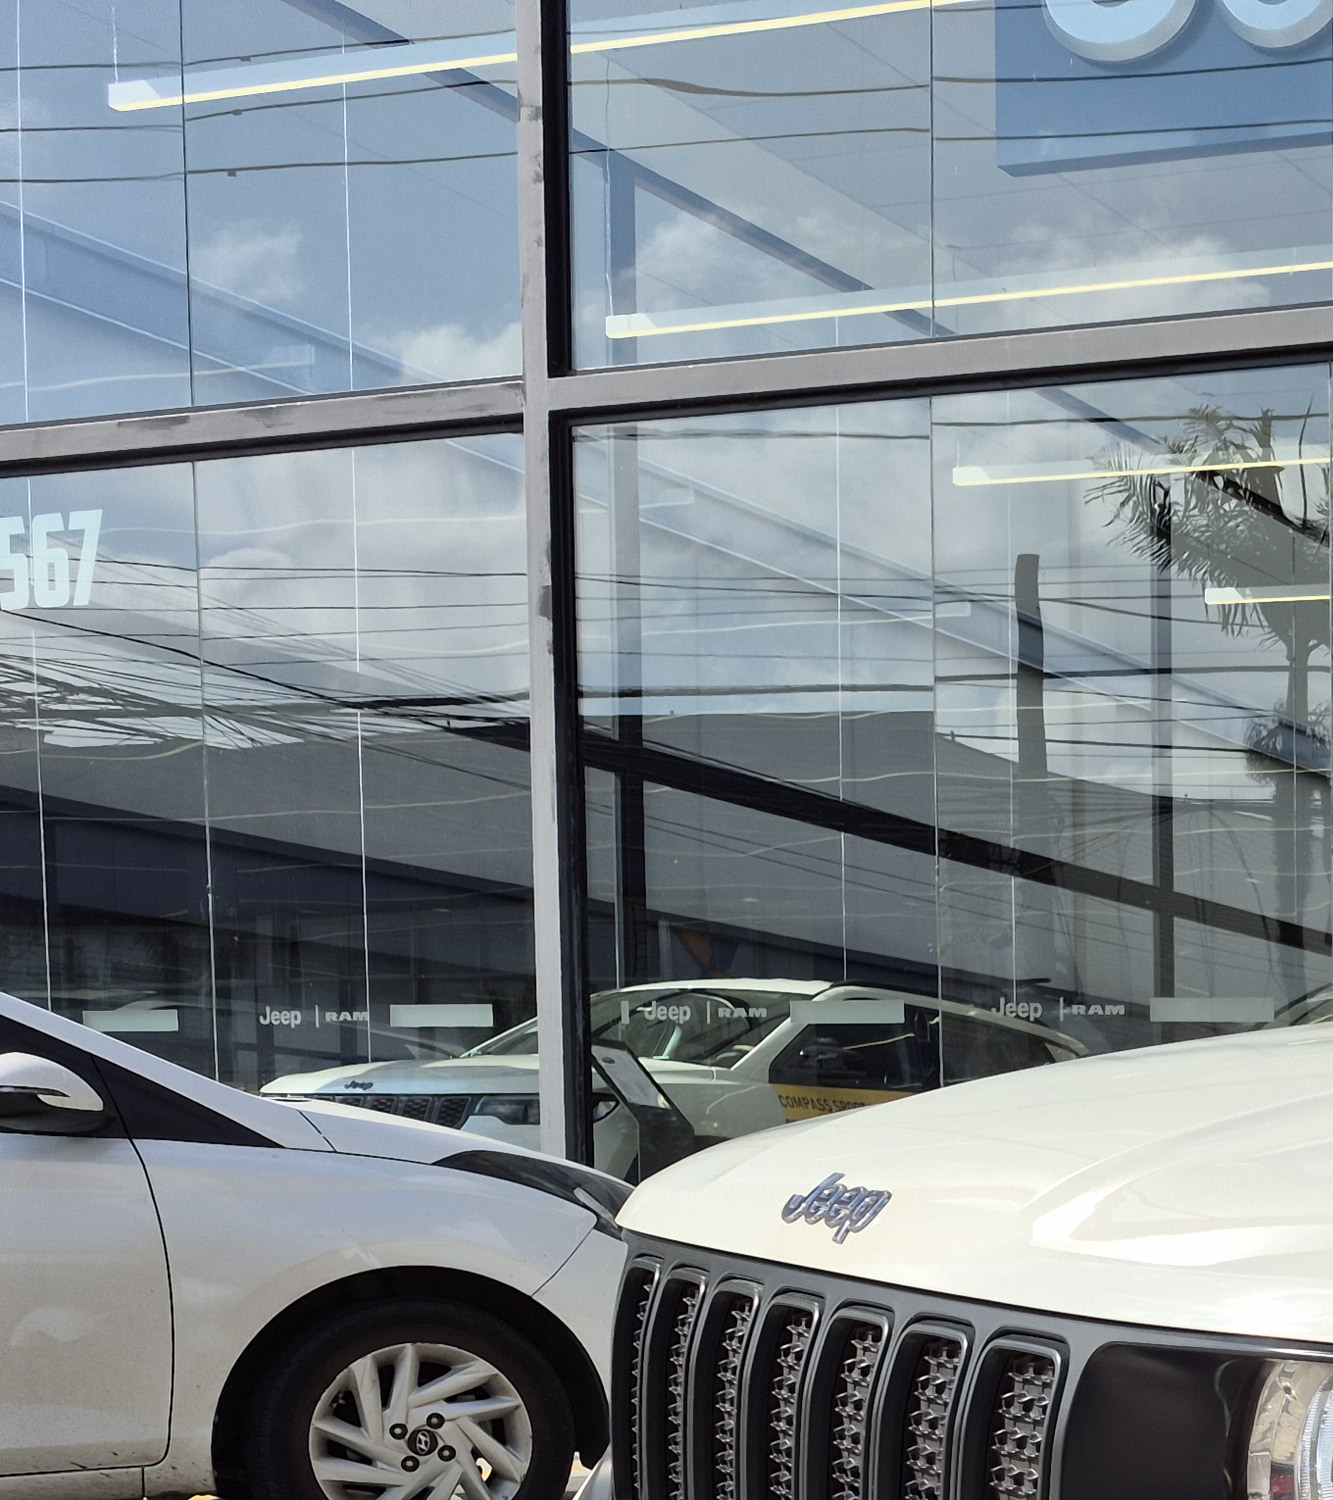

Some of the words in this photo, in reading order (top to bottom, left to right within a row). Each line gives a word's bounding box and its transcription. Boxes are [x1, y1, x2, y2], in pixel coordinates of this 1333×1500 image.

[259, 1006, 301, 1029] Jeep
[325, 1011, 368, 1022] RAM
[643, 1001, 691, 1024] Jeep
[717, 1007, 768, 1018] RAM
[990, 997, 1042, 1022] Jeep
[1071, 1004, 1125, 1016] RAM
[344, 1080, 374, 1091] Jeep
[778, 1094, 833, 1113] COMPASS
[781, 1172, 893, 1245] Jeep
